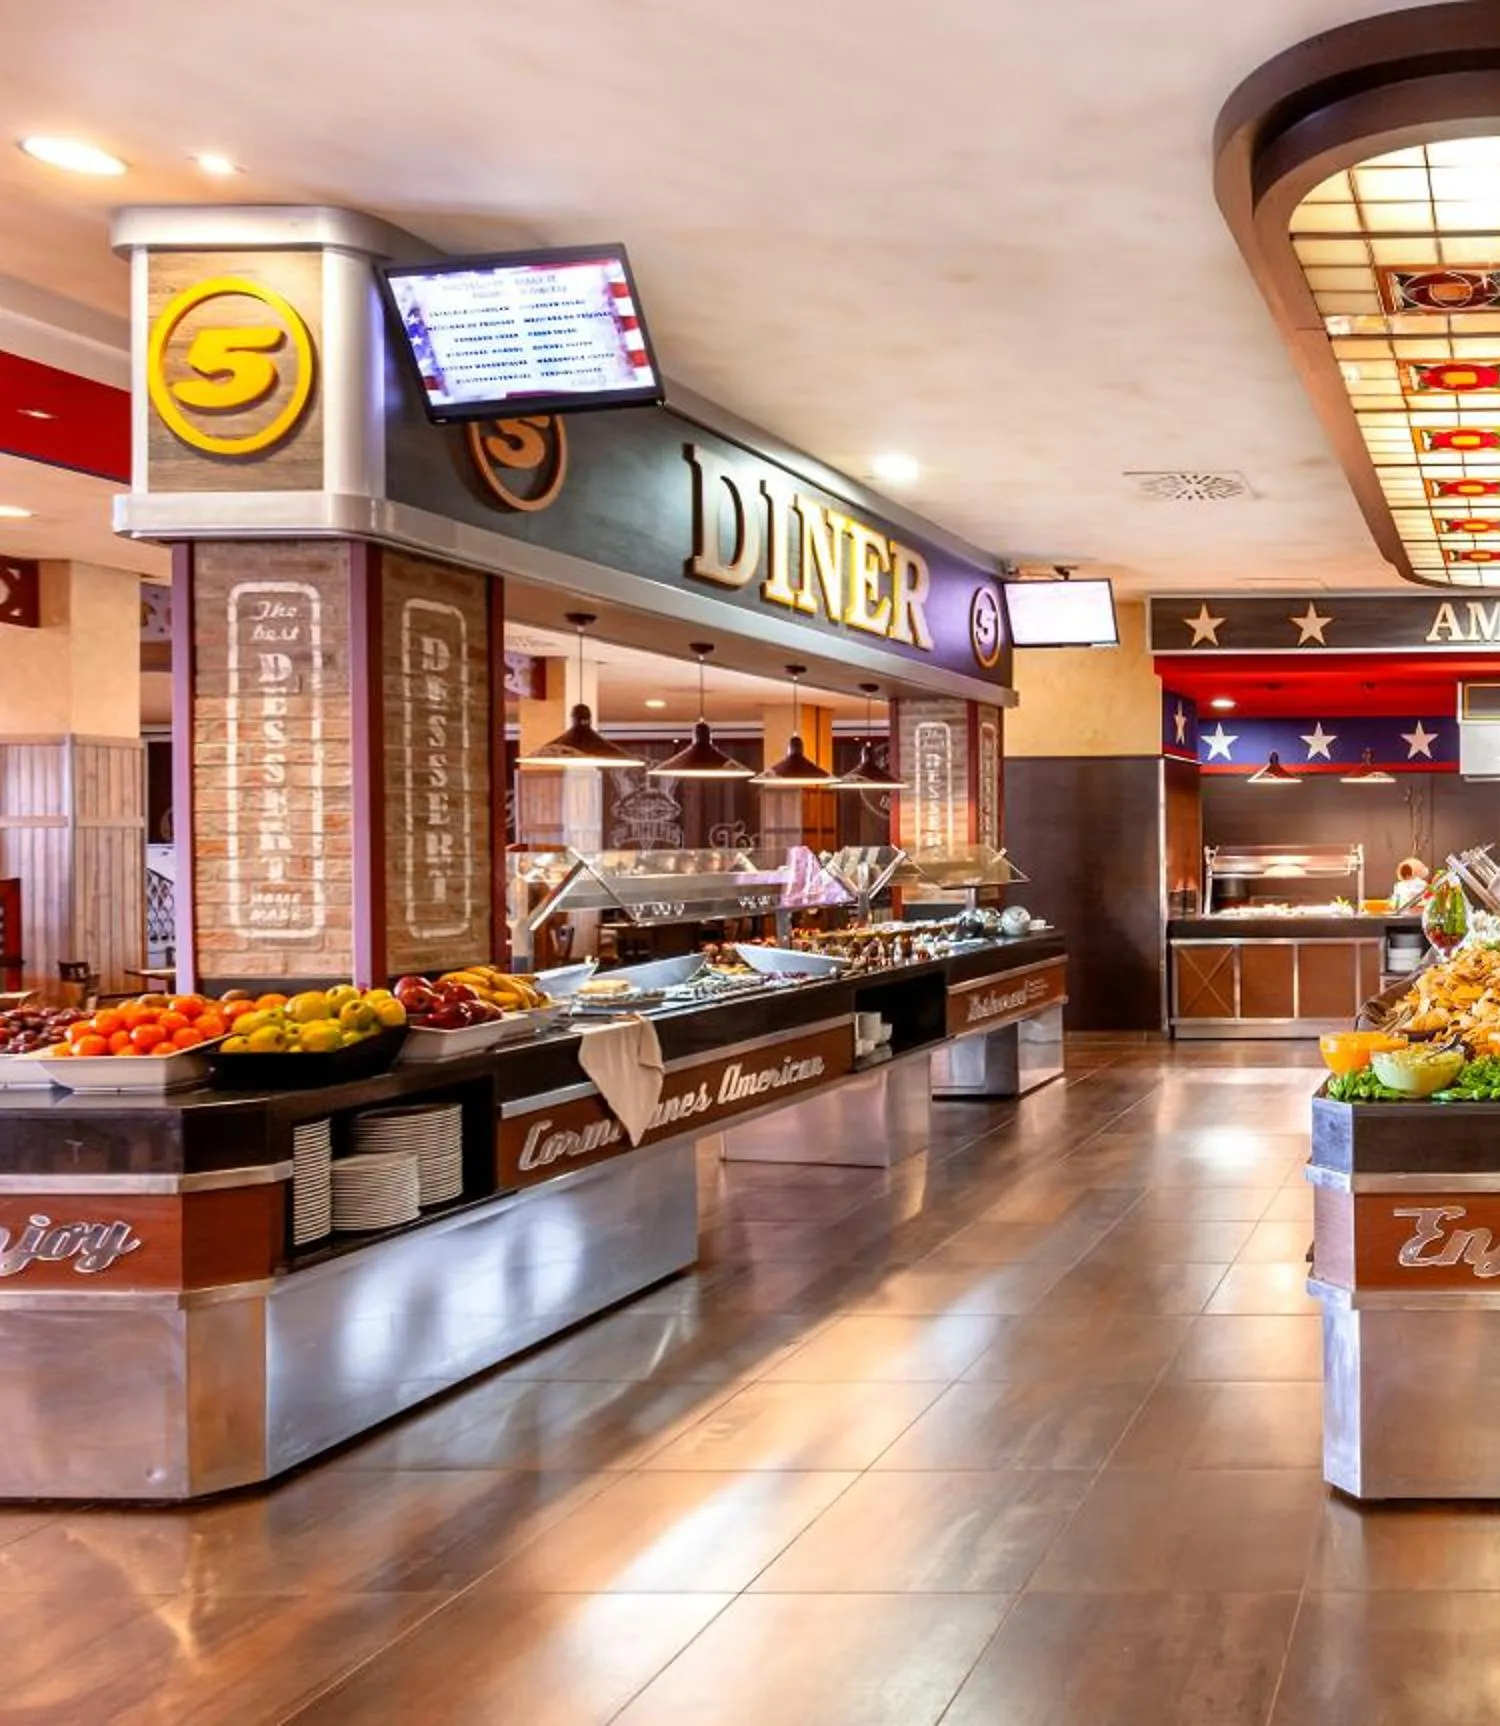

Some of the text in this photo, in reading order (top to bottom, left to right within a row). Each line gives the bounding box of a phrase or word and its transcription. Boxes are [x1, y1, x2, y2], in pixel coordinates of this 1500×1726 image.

[251, 600, 302, 621] The
[684, 444, 934, 652] DINER
[252, 624, 300, 642] best
[258, 653, 293, 884] DESSERT
[421, 635, 456, 904] DESSERT
[717, 1054, 825, 1105] American
